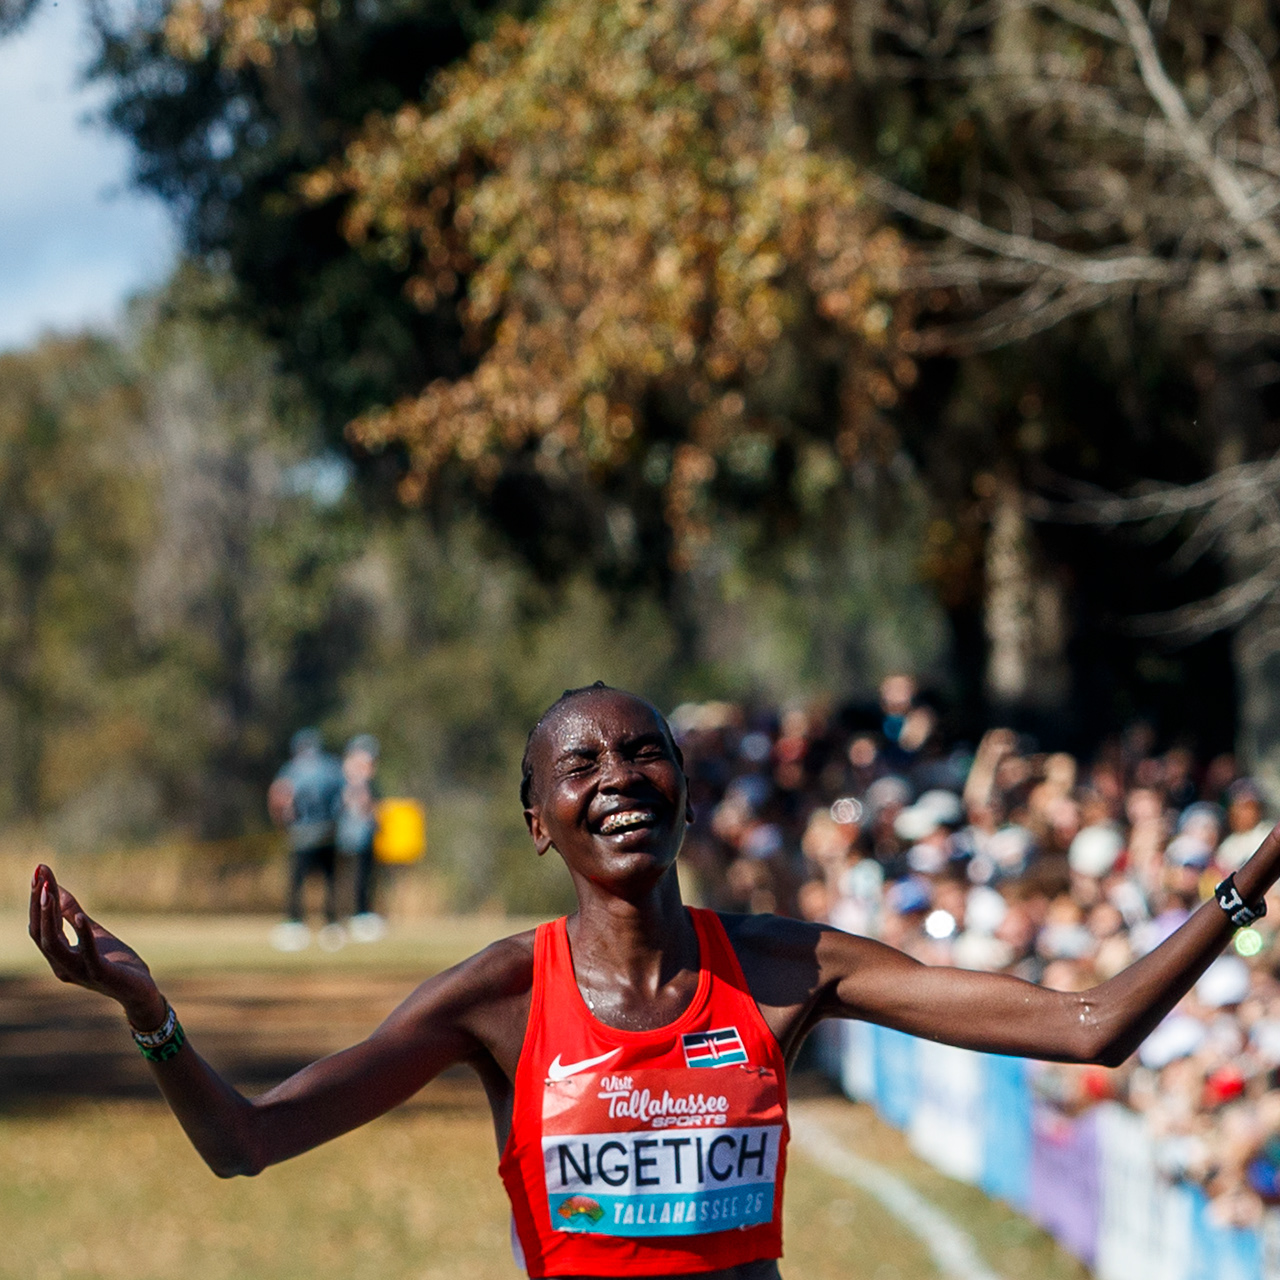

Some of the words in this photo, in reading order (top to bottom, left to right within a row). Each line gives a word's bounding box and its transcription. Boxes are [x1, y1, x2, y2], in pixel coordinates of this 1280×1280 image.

[601, 1075, 633, 1092] Visit
[598, 1089, 729, 1122] Tallahassee
[652, 1113, 727, 1128] SPORTS
[558, 1132, 768, 1187] NGETICH
[613, 1197, 738, 1225] TALLAHASSEE
[744, 1192, 764, 1213] 26
